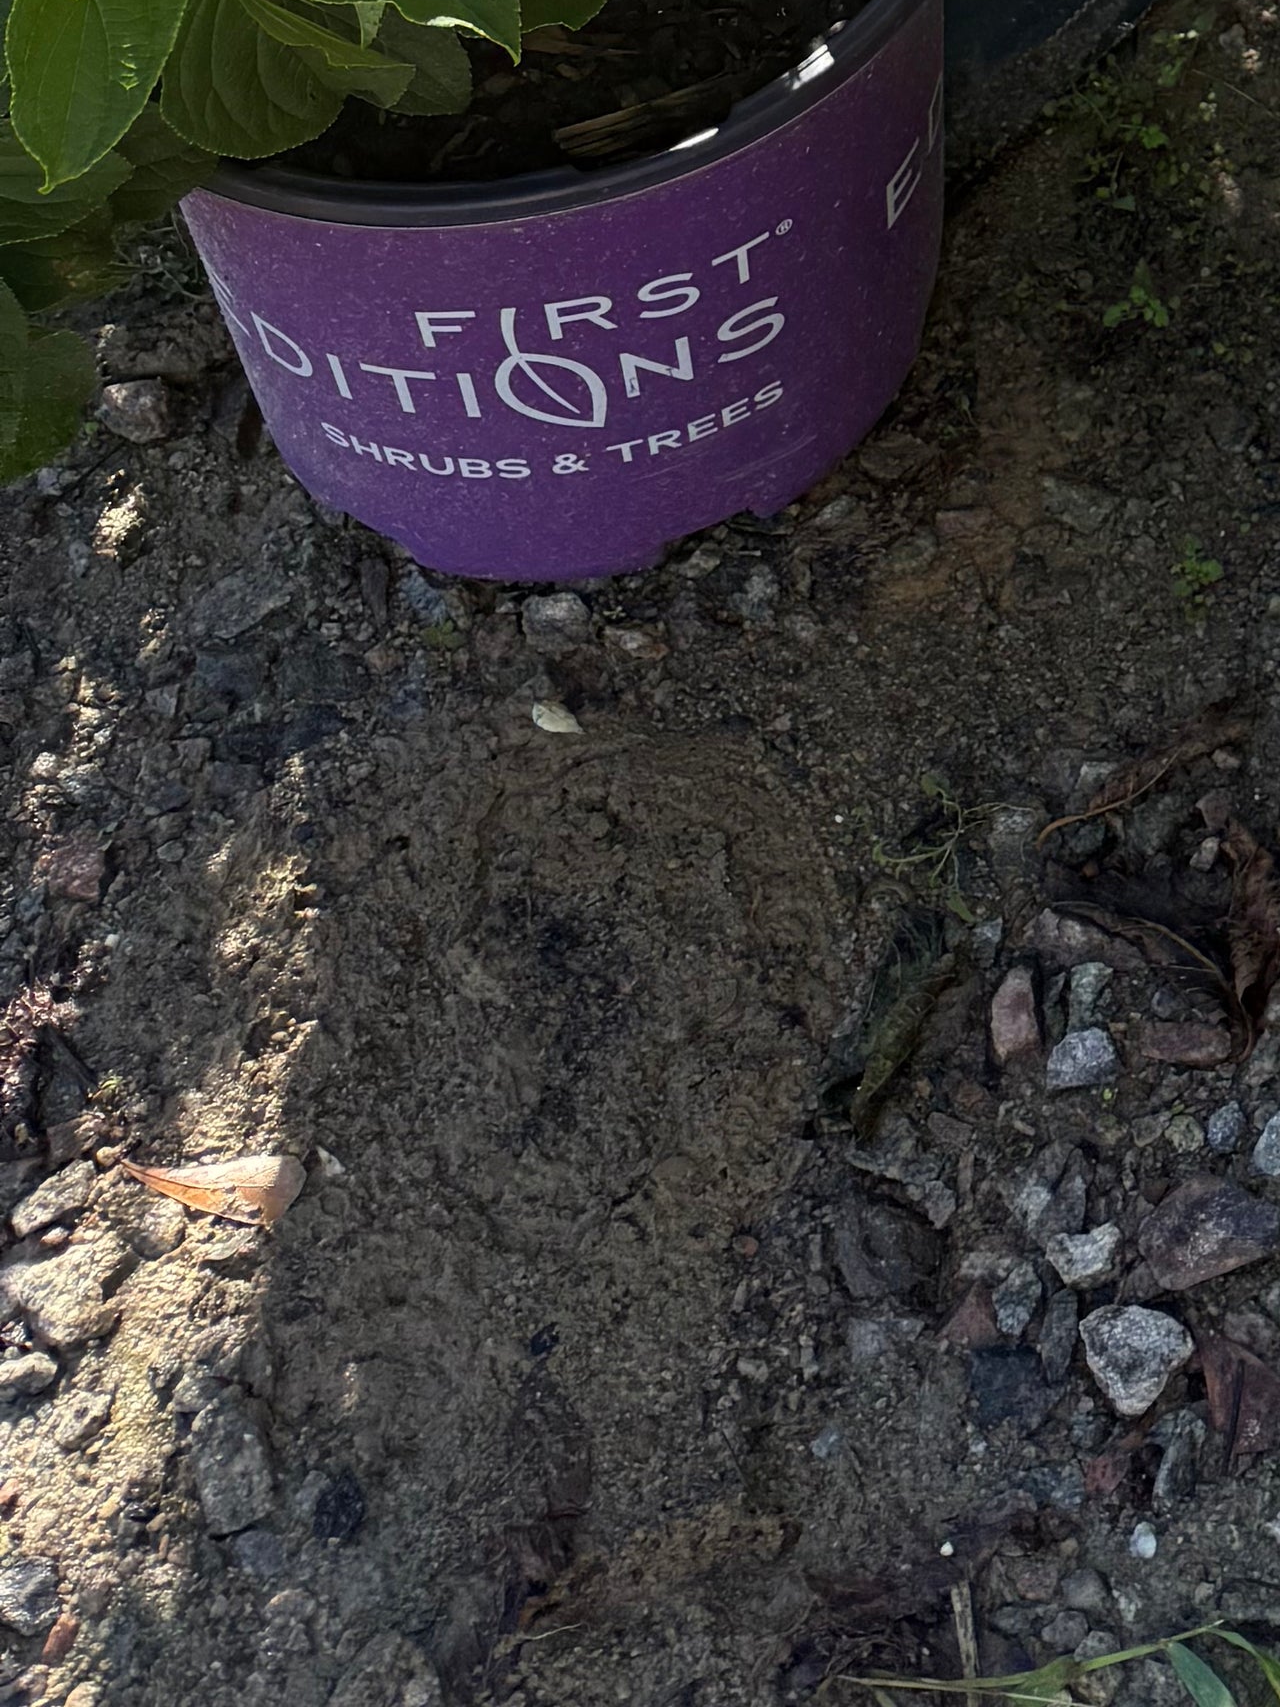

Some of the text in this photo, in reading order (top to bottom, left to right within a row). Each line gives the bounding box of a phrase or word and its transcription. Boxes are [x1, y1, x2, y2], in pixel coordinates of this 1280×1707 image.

[320, 380, 785, 482] SHRUBS & TREES
